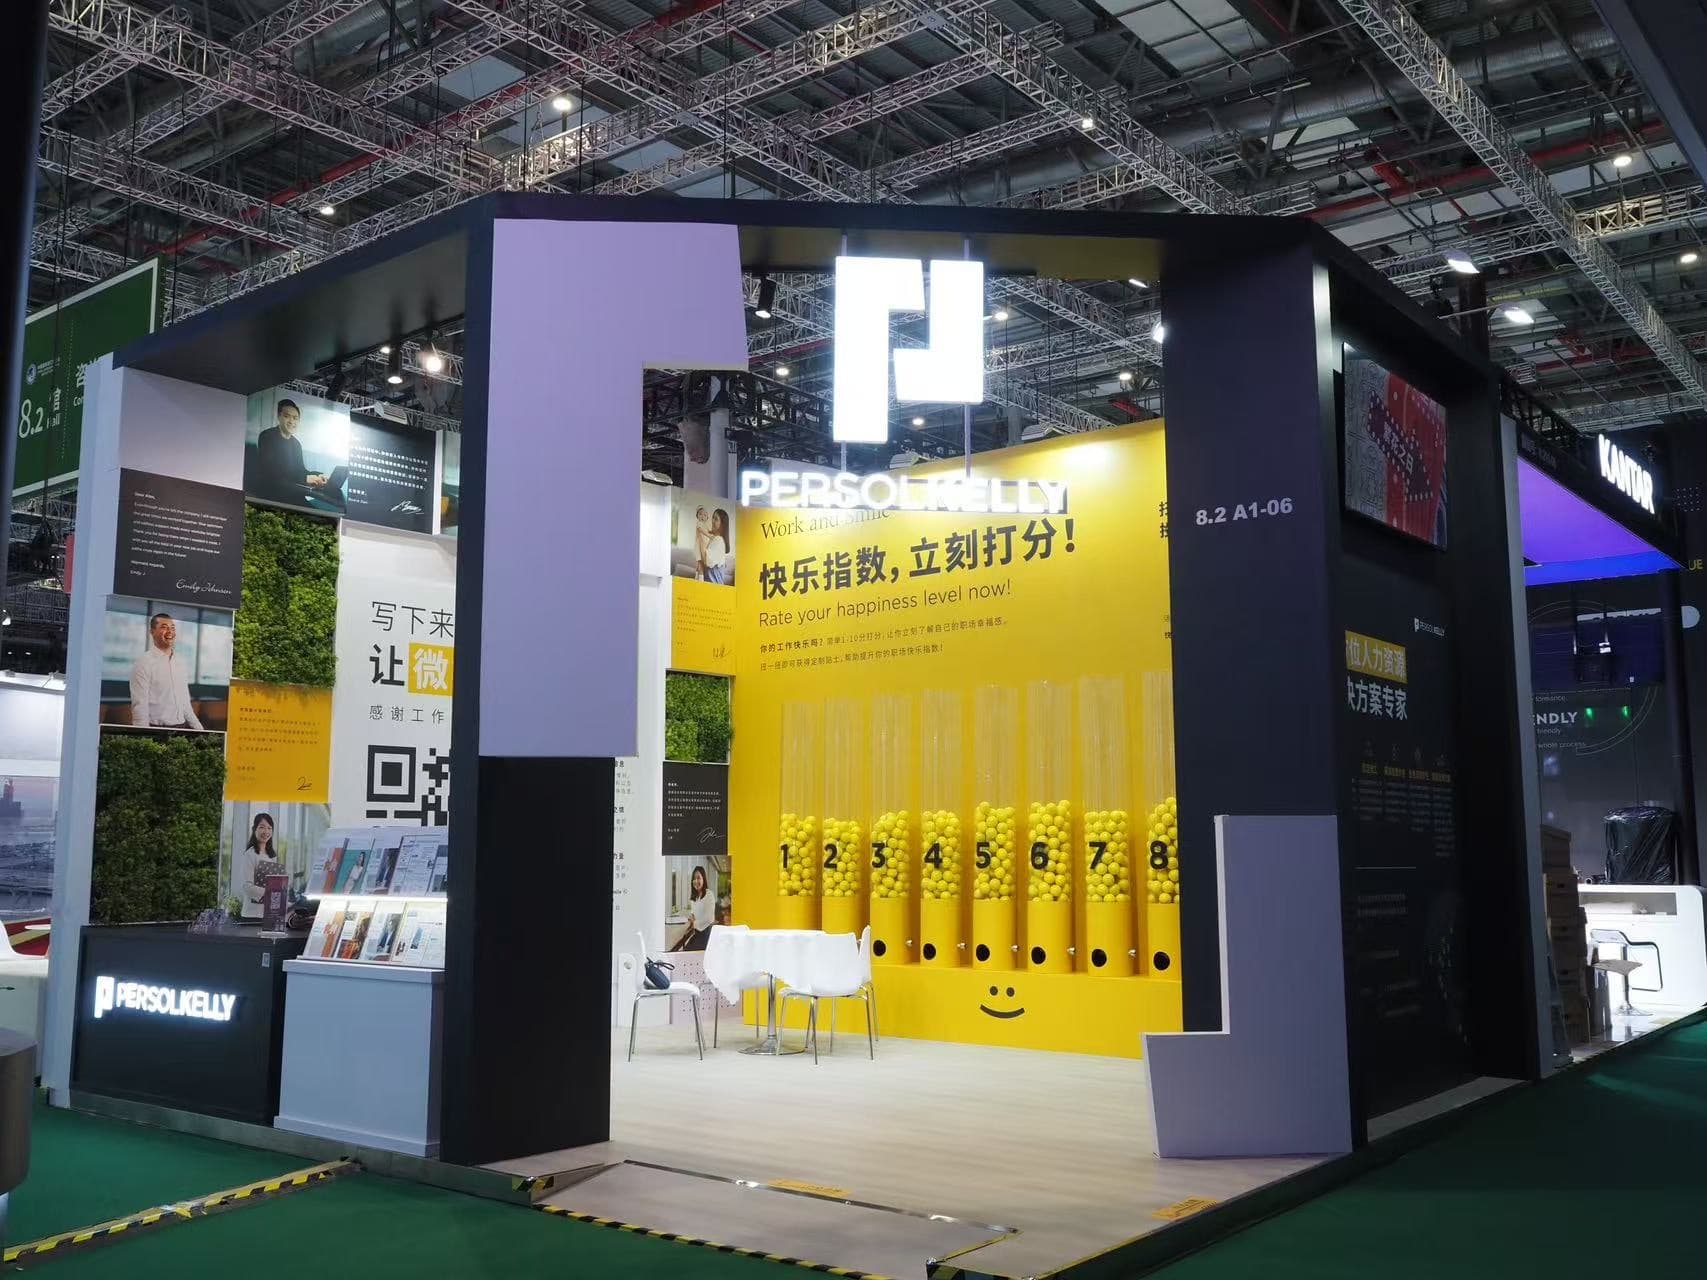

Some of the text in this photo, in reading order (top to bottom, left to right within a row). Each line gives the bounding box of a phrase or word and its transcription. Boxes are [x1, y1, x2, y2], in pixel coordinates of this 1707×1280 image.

[18, 399, 44, 439] 8.2
[1598, 433, 1655, 514] KANTAR
[741, 471, 1067, 514] PERSOLKELLY
[761, 520, 804, 540] Work
[809, 511, 841, 531] and
[1195, 507, 1227, 526] 8.2
[1232, 497, 1293, 521] A1-06
[371, 601, 454, 638] 写下来
[759, 579, 1012, 627] Rate your happiness level now!
[369, 643, 448, 690] 让微
[369, 705, 445, 724] 感谢工作
[1532, 711, 1578, 726] NDLY
[780, 840, 1169, 870] 1 2 3 4 5 6 7 8
[115, 983, 236, 1021] PERSOLKELLY
